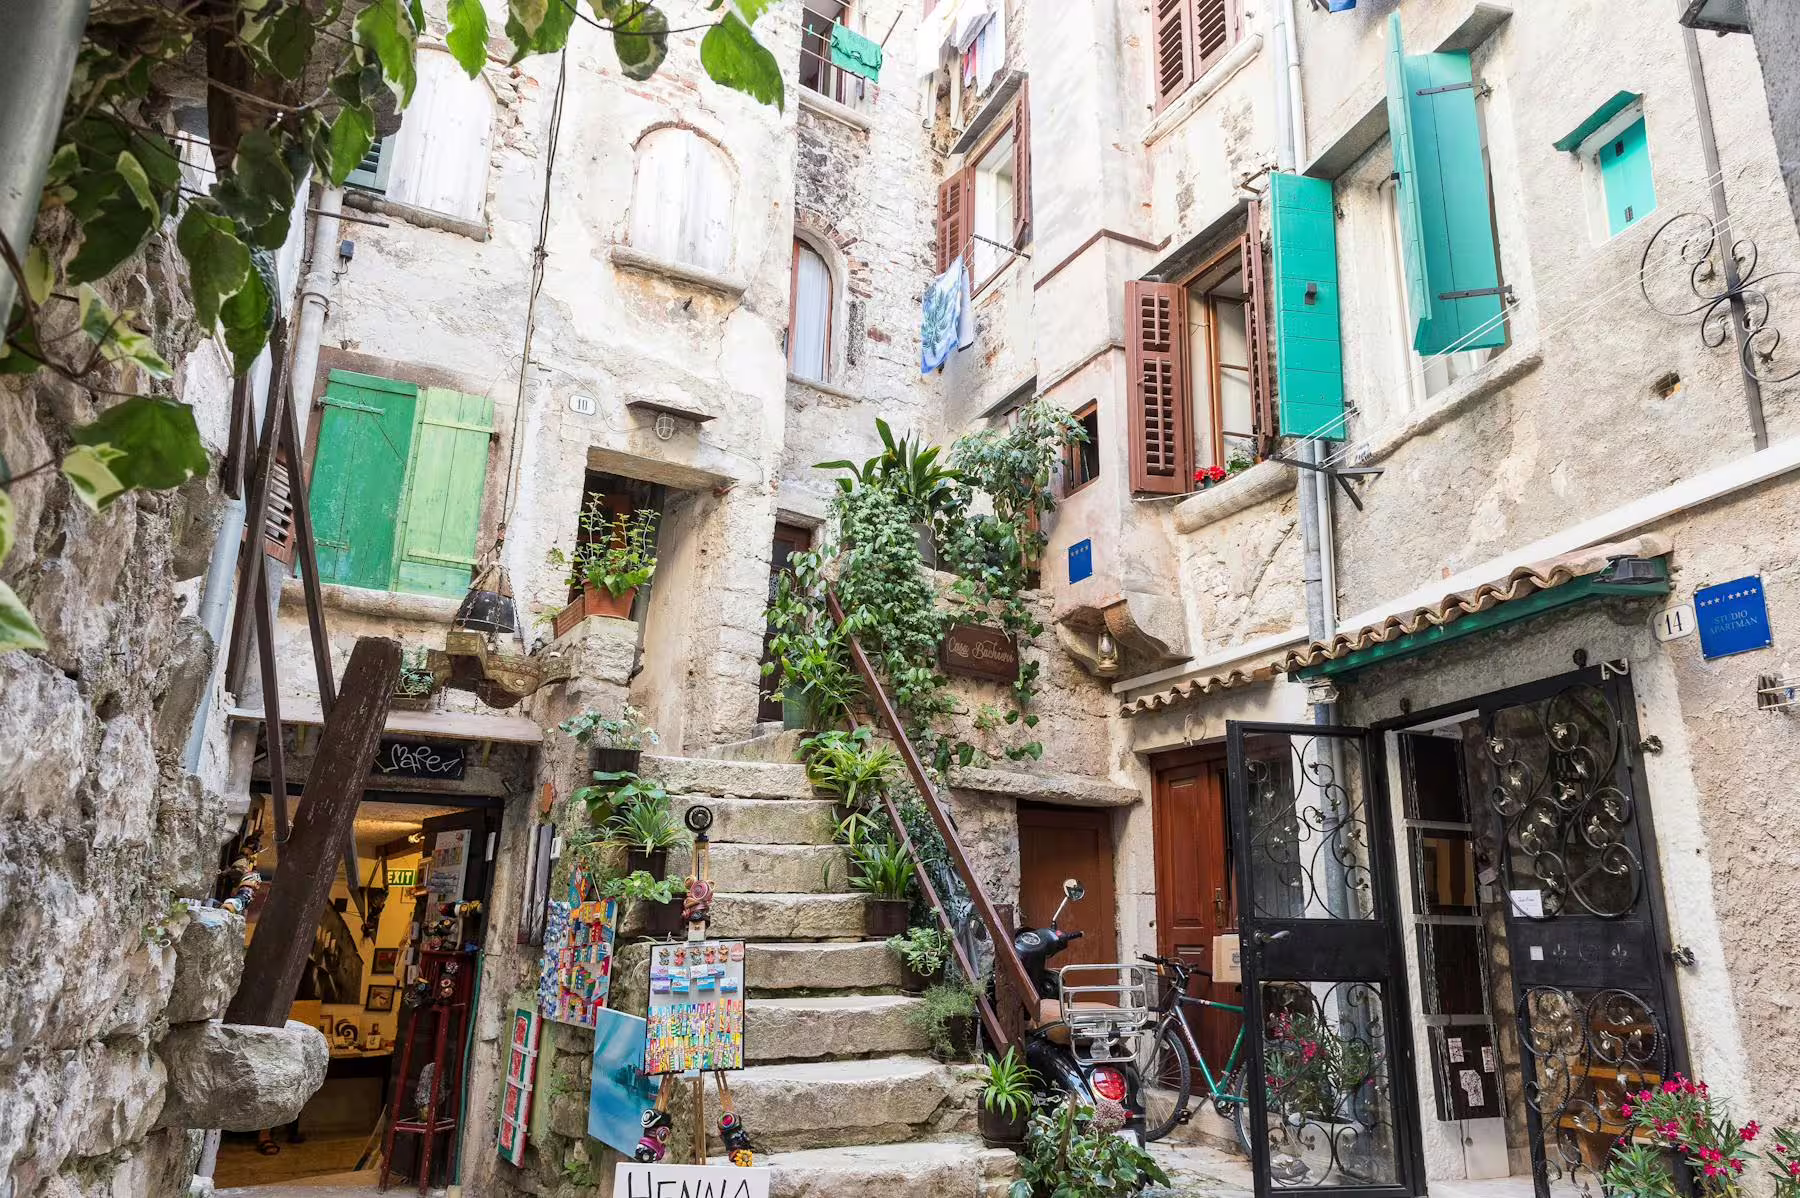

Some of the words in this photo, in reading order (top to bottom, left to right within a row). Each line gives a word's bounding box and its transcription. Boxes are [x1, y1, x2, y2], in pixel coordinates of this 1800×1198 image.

[1664, 610, 1683, 635] 14
[1709, 616, 1758, 635] APARTMAN
[1713, 609, 1748, 625] STUDIO
[387, 871, 413, 884] EXIT
